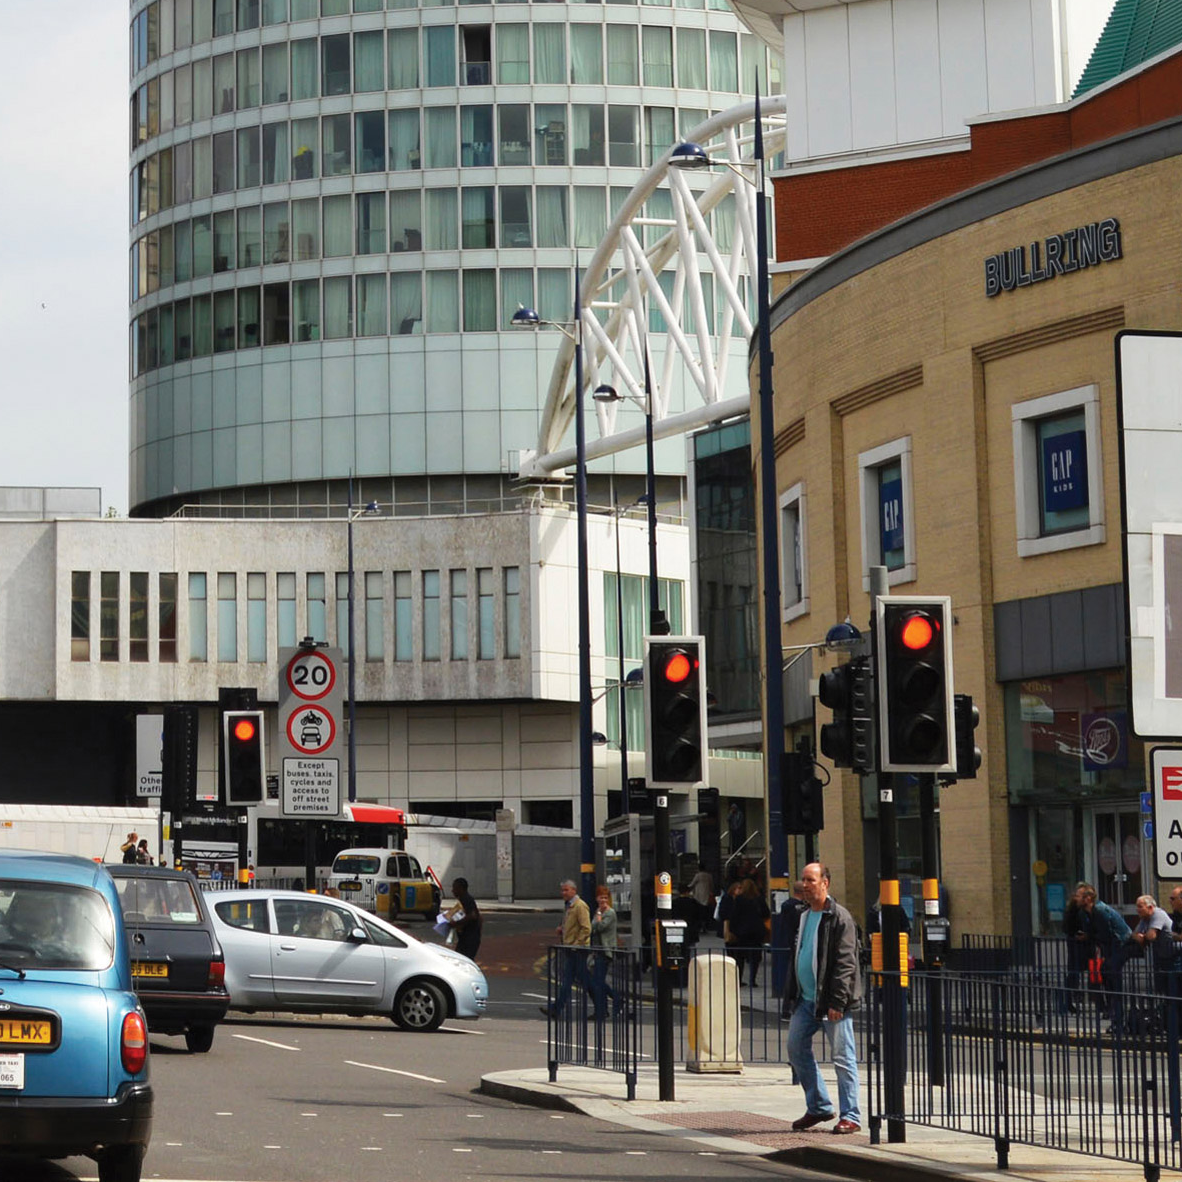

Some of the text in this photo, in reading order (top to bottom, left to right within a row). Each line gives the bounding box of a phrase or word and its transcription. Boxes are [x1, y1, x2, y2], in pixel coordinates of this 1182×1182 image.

[984, 217, 1123, 298] BULLRING
[1051, 449, 1073, 481] GAP
[1053, 484, 1074, 493] KIDS
[884, 499, 899, 532] GAP
[294, 665, 328, 686] 20
[298, 761, 325, 770] Except
[140, 776, 162, 785] Othe
[290, 778, 332, 787] cycles and
[139, 785, 162, 794] traffi
[293, 787, 330, 795] access to
[292, 795, 330, 803] off street
[293, 804, 329, 812] premises
[9, 1021, 43, 1040] LMX
